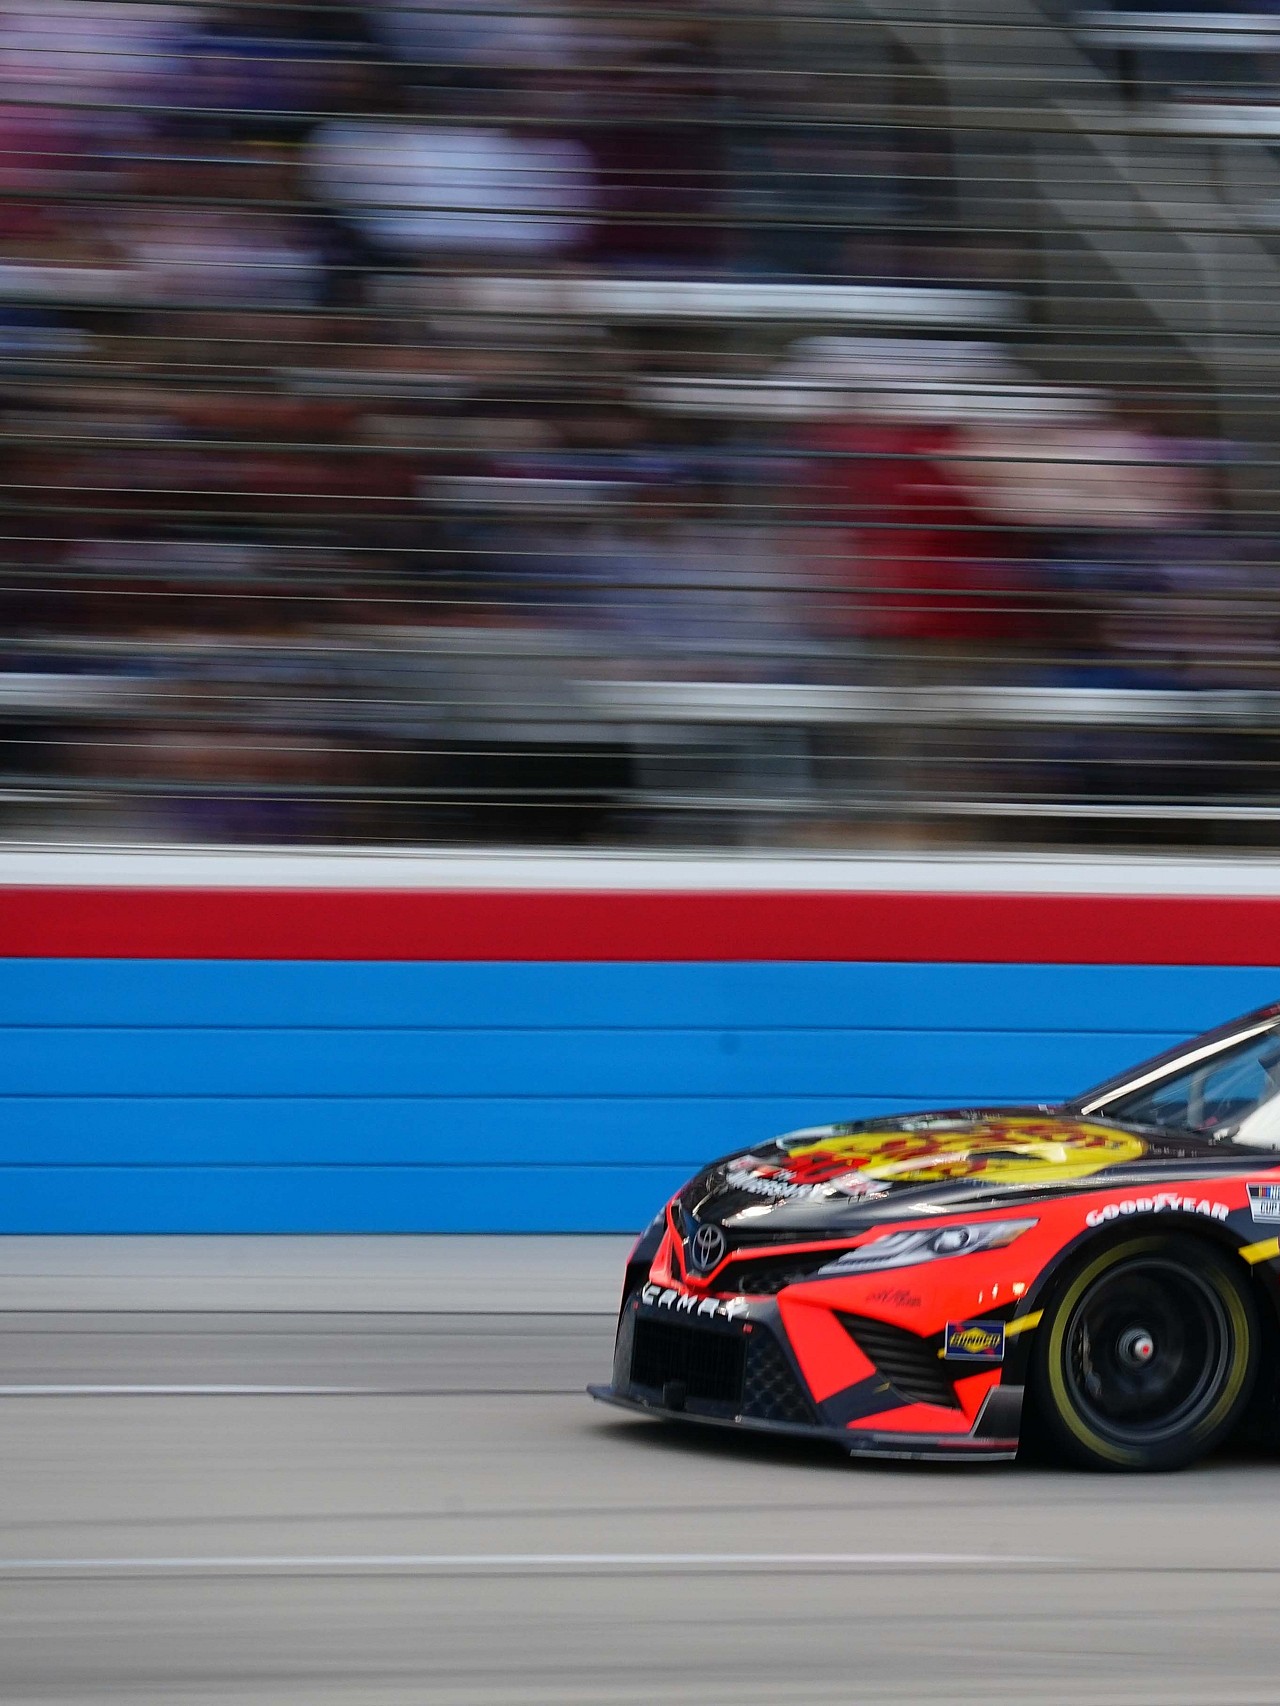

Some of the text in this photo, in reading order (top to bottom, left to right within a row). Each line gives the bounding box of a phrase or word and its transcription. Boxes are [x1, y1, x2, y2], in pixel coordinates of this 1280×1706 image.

[1085, 1192, 1229, 1228] GOODYEAR
[1261, 1202, 1277, 1214] CUP
[949, 1333, 1001, 1348] SUNOCO
